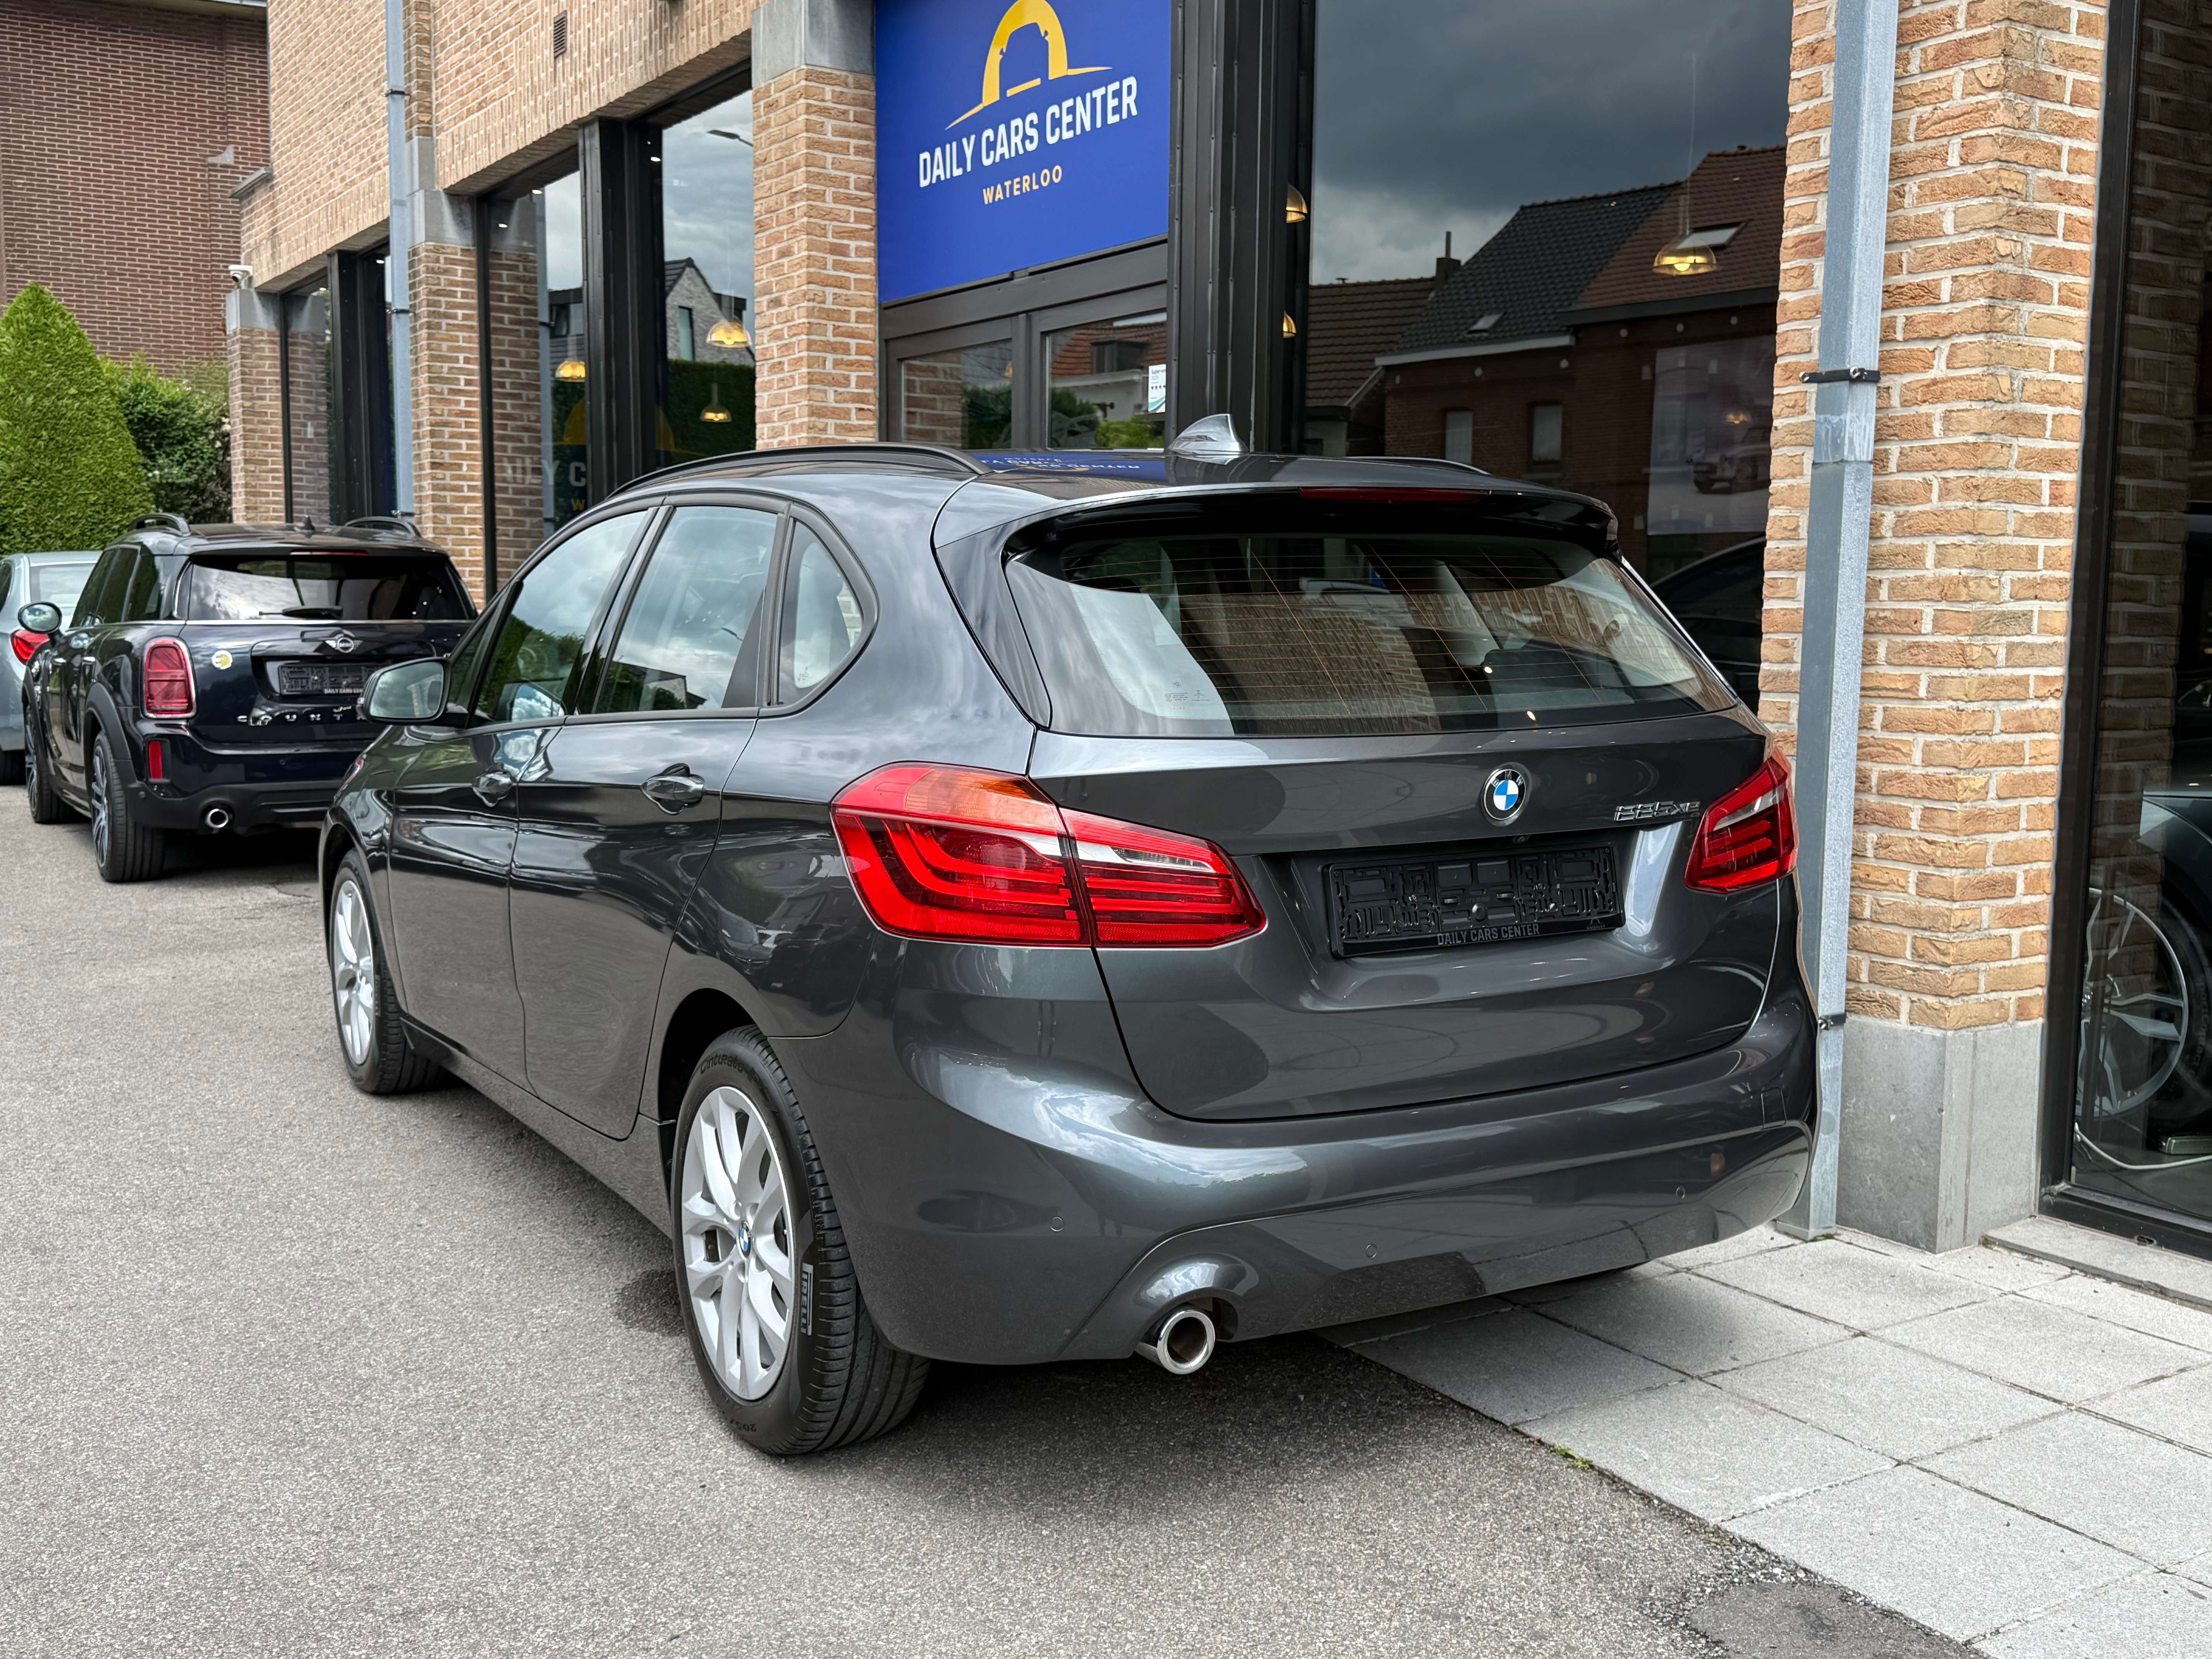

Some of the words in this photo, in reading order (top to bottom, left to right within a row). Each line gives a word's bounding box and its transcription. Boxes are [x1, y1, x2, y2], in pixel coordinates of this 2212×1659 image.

[919, 134, 975, 188] DAILY
[981, 112, 1039, 166] CARS
[1046, 76, 1138, 144] CENTER
[983, 165, 1062, 204] WATERLOO
[1491, 770, 1524, 788] BMW
[1437, 931, 1467, 945] DAILY
[1470, 927, 1499, 941] CARS
[1501, 924, 1540, 938] CENTER
[800, 1262, 814, 1336] PIRELLI
